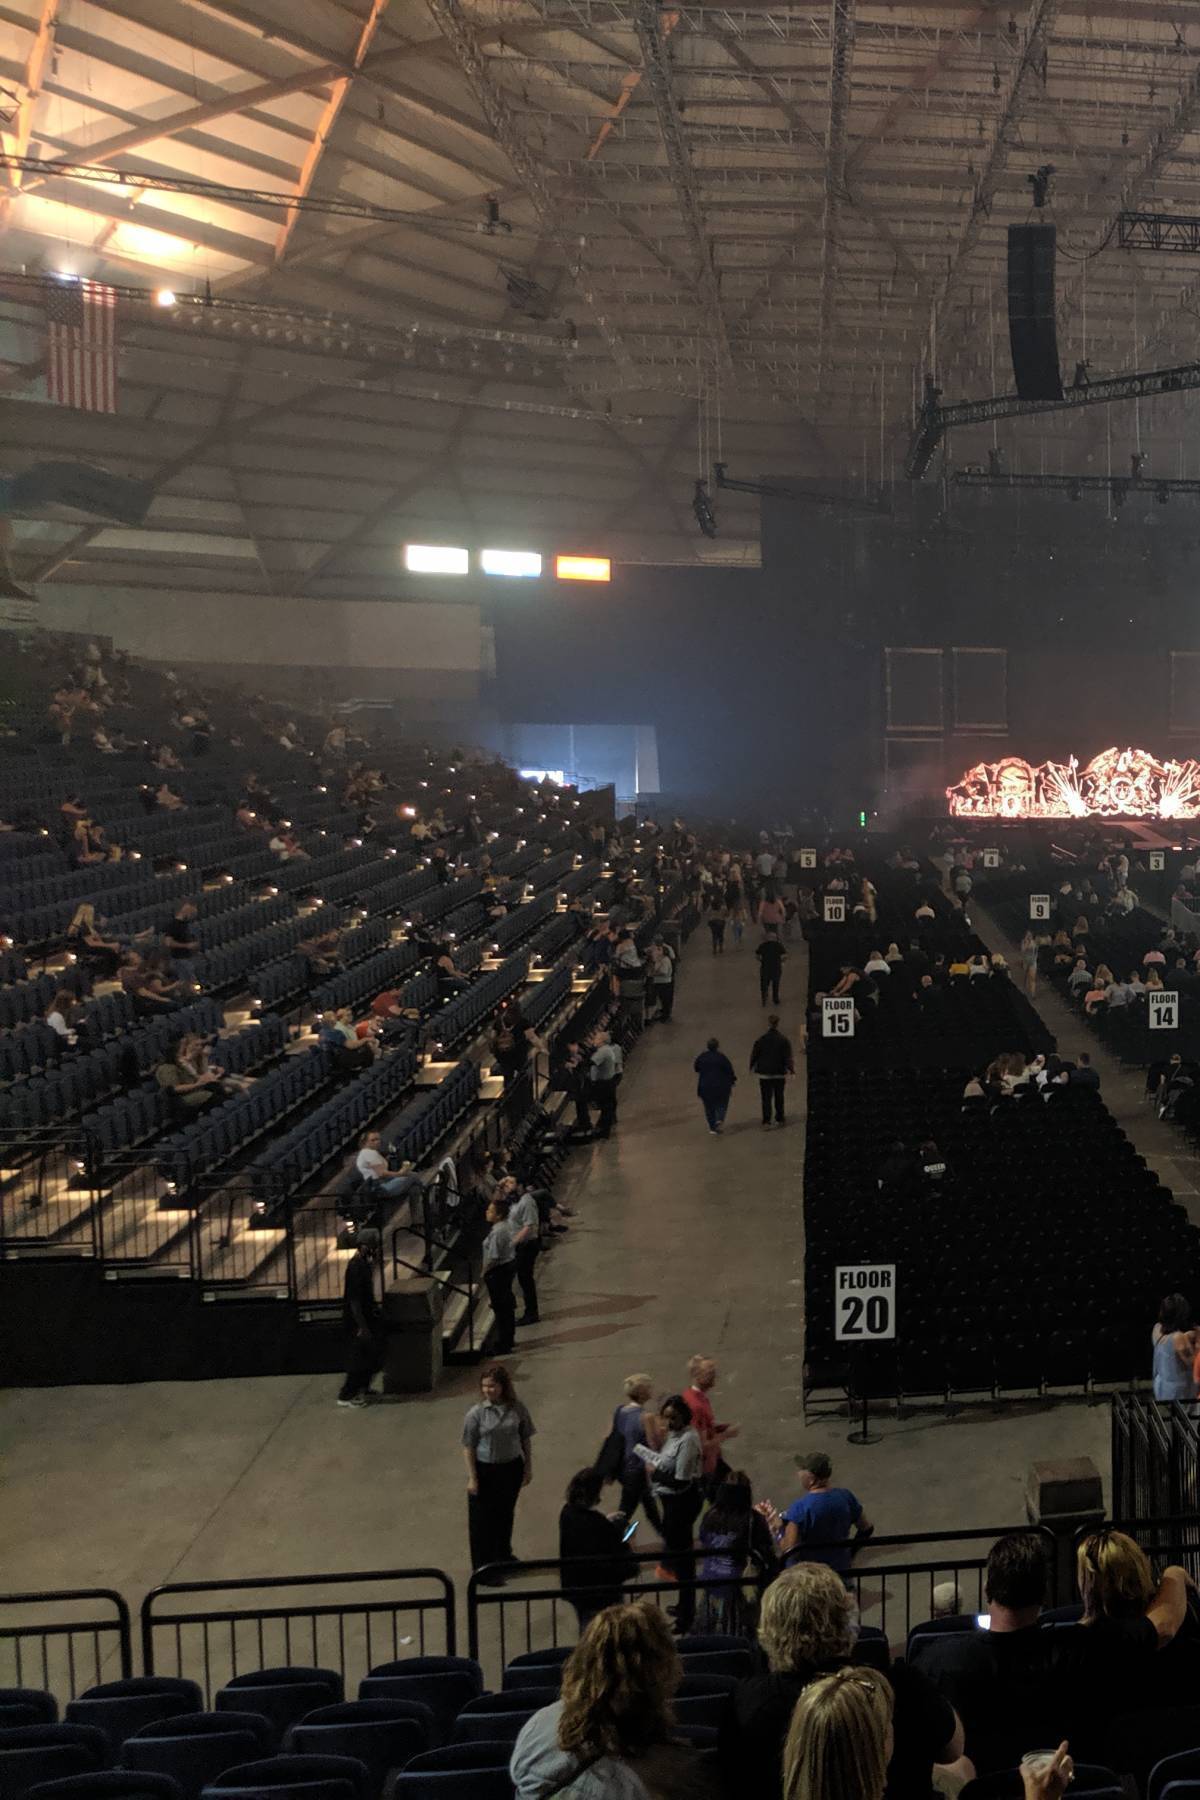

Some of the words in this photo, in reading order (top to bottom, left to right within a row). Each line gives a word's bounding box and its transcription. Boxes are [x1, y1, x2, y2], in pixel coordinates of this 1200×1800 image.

[805, 856, 812, 866] 5
[1154, 859, 1160, 868] 3
[828, 907, 841, 919] 10
[1036, 905, 1044, 917] 9
[825, 1000, 851, 1010] FLOOR
[1152, 995, 1176, 1003] FLOOR
[1154, 1007, 1174, 1025] 14
[828, 1014, 850, 1033] 15
[840, 1270, 892, 1289] FLOOR
[842, 1296, 889, 1334] 20
